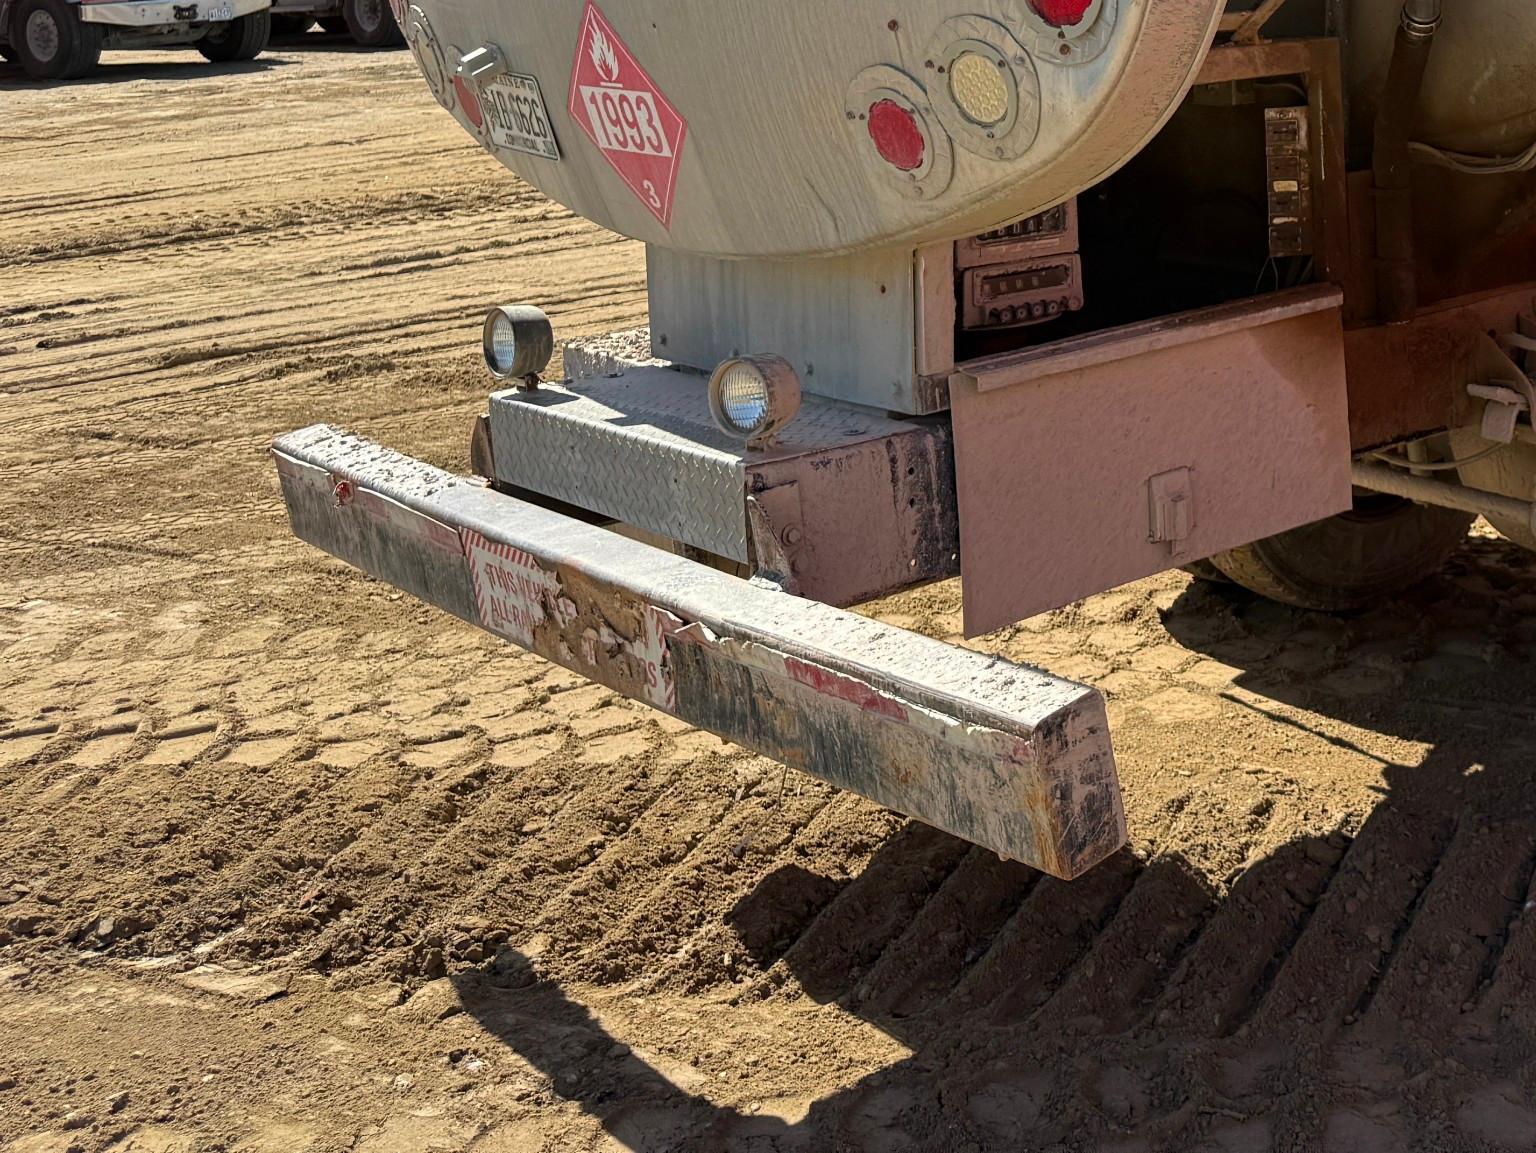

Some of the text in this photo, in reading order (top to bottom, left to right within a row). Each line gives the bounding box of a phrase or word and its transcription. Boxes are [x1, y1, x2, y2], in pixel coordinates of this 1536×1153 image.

[588, 93, 665, 155] 1993
[643, 179, 662, 210] 3
[484, 561, 517, 594] THIS
